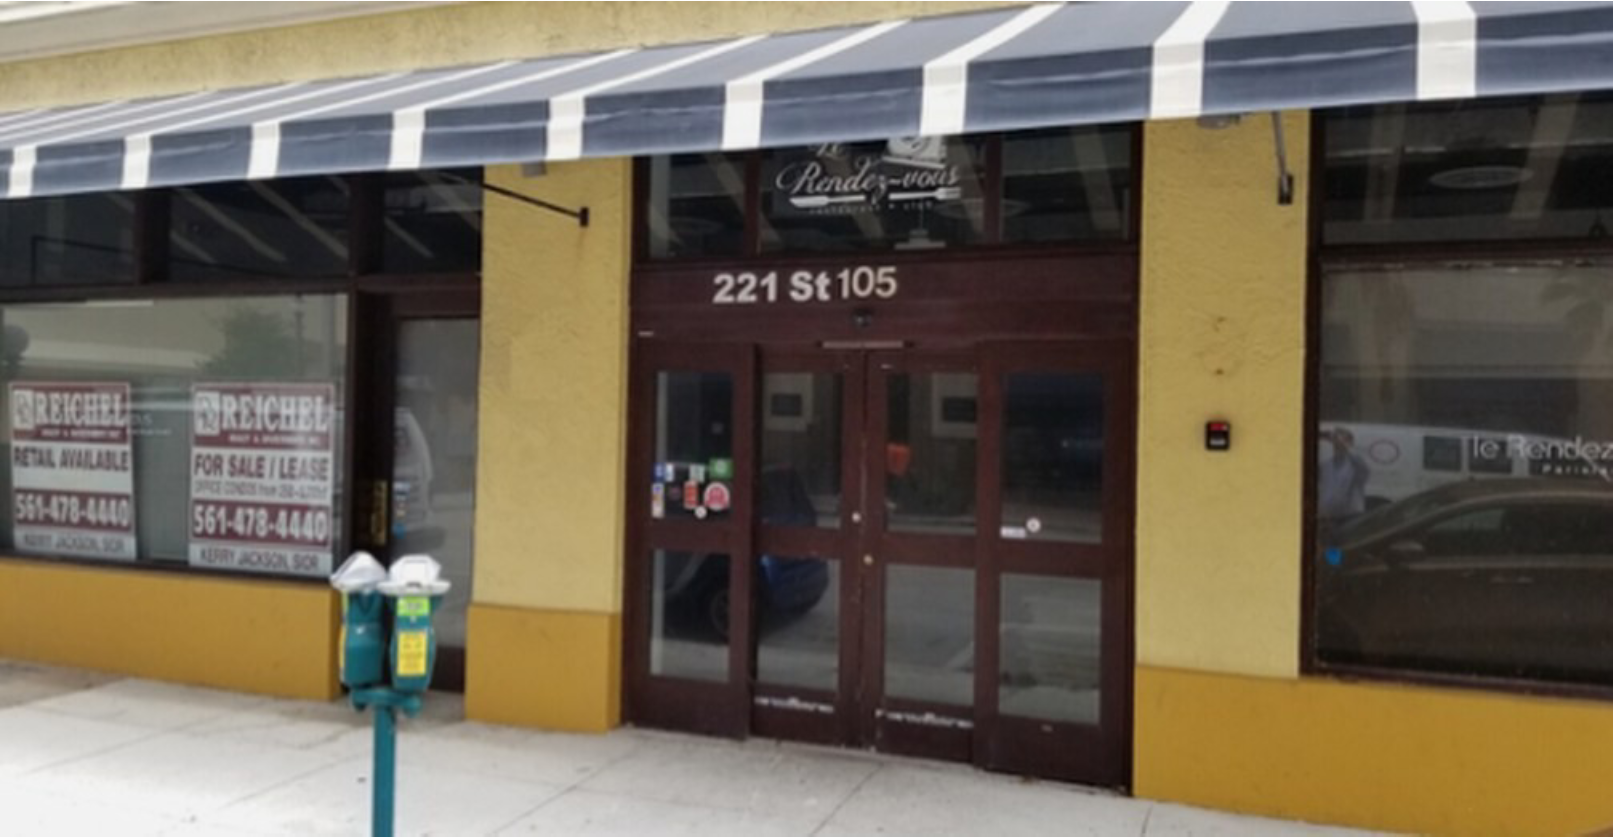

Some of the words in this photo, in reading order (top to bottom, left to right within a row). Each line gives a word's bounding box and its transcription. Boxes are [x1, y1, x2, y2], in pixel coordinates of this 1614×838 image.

[775, 155, 961, 205] Rendez-vous
[712, 271, 778, 304] 221
[788, 271, 831, 301] St
[837, 266, 897, 298] 105
[35, 391, 128, 426] REICHEL
[222, 393, 328, 432] REICHEL
[14, 446, 56, 469] RETAIL
[60, 447, 130, 472] AVAILABLE
[1507, 433, 1614, 461] Rendez
[194, 453, 224, 475] FOR
[228, 454, 266, 478] SALE
[279, 456, 329, 481] LEASE
[16, 492, 130, 528] 561-478-4440
[194, 503, 329, 543] 561-478-4440
